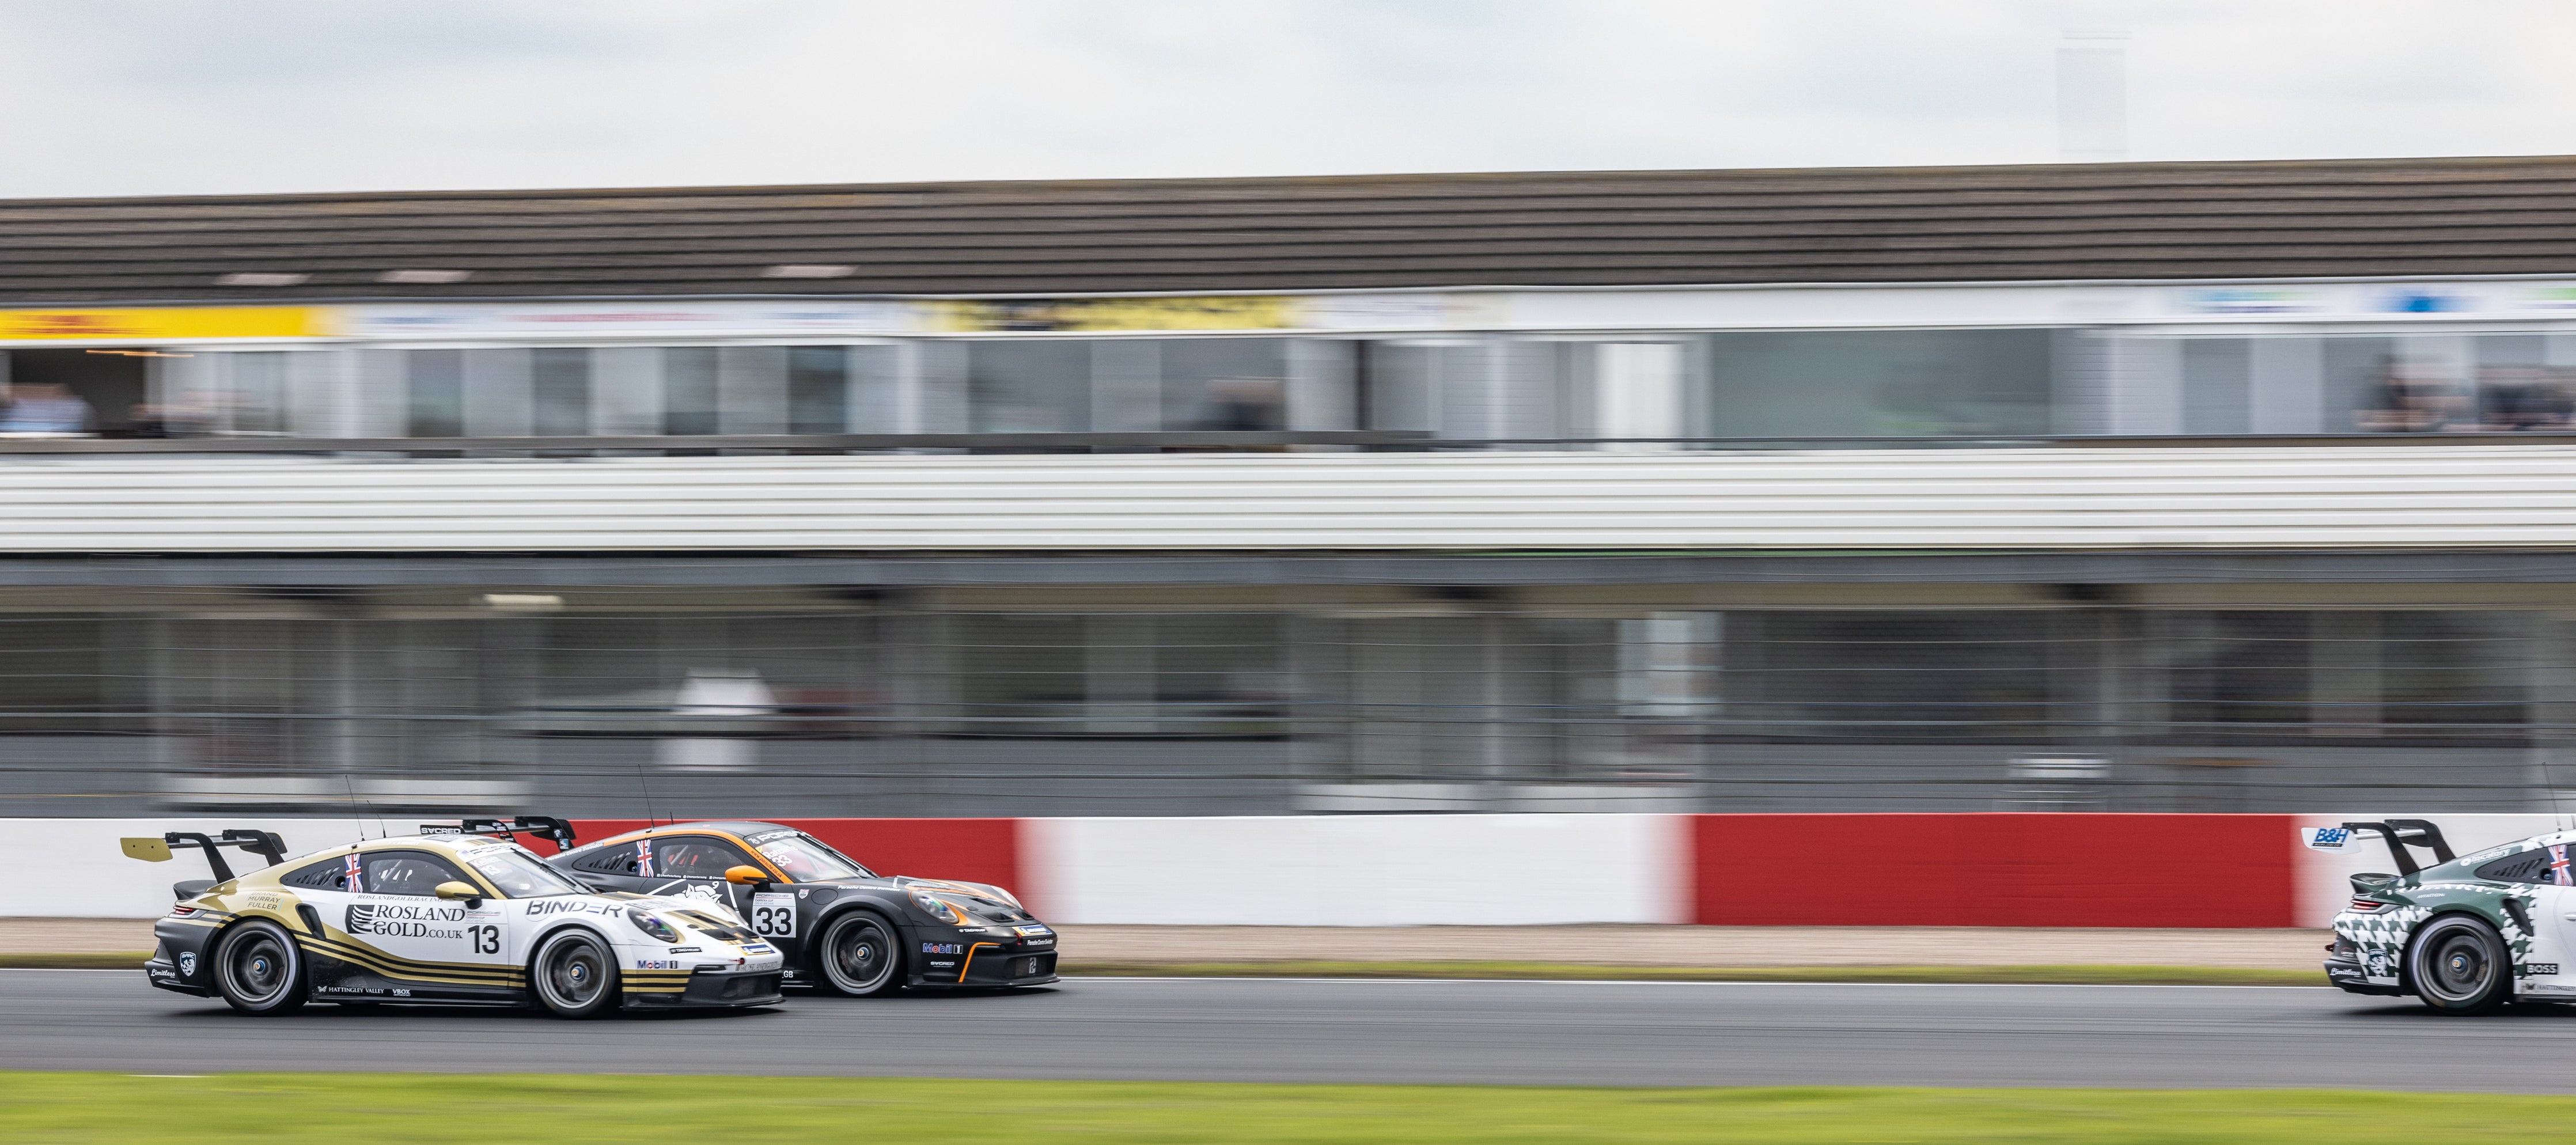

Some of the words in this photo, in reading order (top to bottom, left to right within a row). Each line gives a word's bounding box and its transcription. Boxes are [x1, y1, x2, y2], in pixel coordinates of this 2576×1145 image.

[2314, 828, 2349, 843] B&H
[772, 855, 793, 867] 33
[358, 894, 443, 903] ROSLANDGOLD.RACING
[248, 902, 277, 910] FULLER
[526, 900, 623, 917] BINDER
[376, 905, 465, 922] ROSLAND
[756, 907, 791, 935] 33
[373, 921, 463, 939] GOLD.CO.UK
[468, 925, 499, 954] 13
[923, 943, 953, 954] Mobil
[637, 960, 667, 969] Mobil
[2526, 965, 2557, 973] BOSS
[150, 968, 175, 977] Limitless
